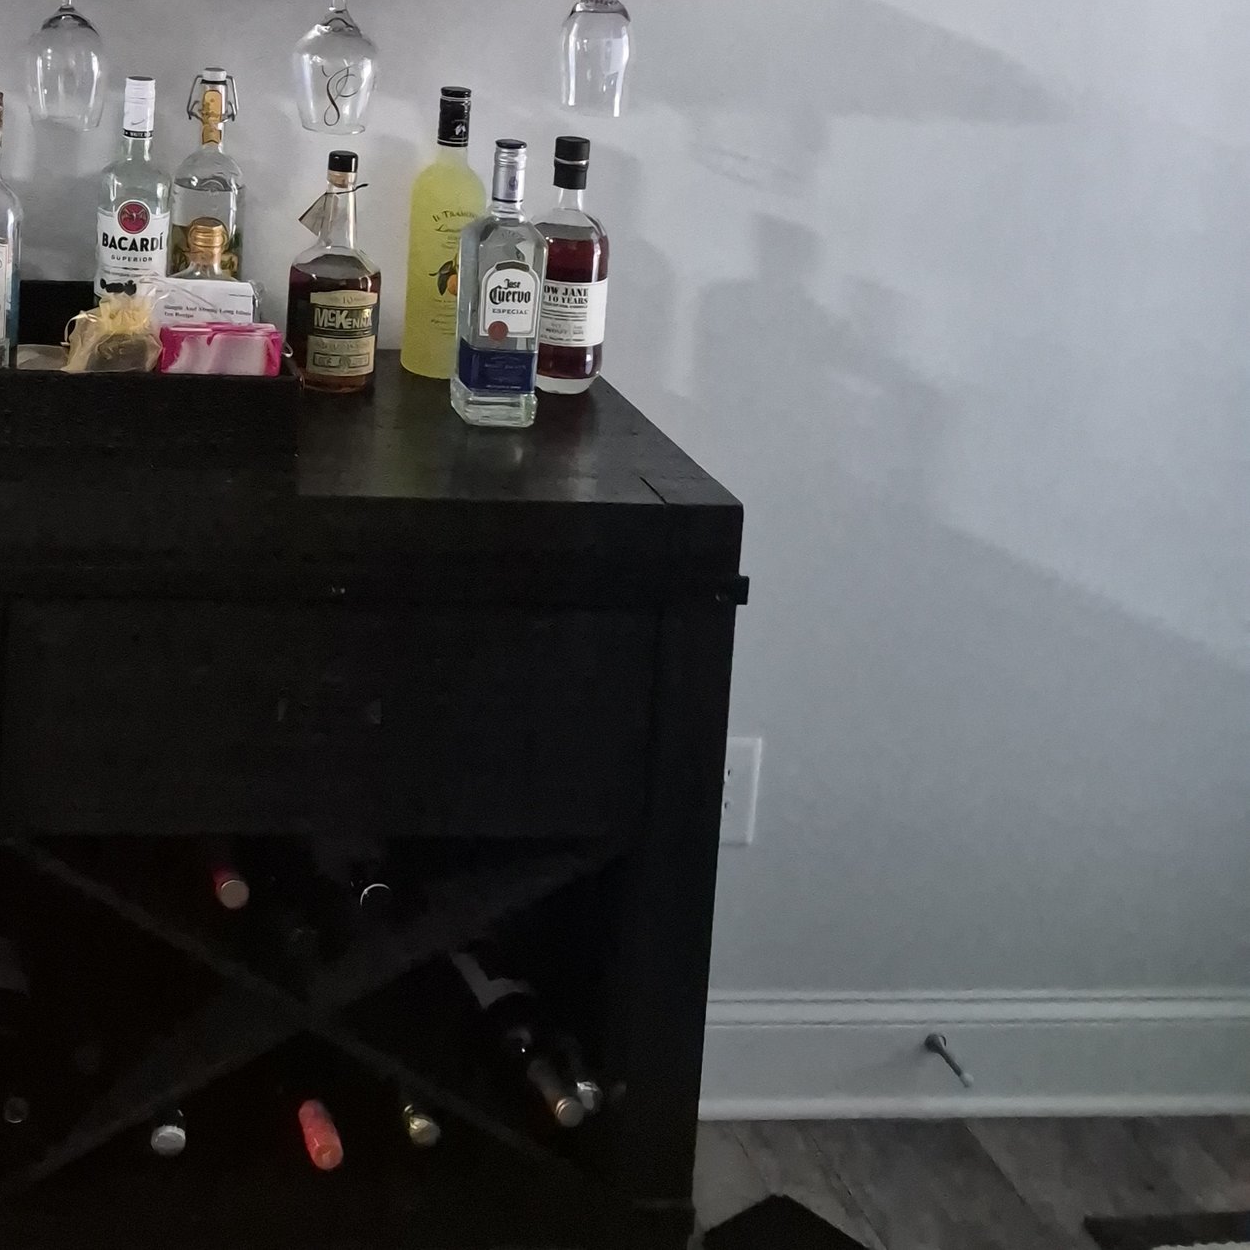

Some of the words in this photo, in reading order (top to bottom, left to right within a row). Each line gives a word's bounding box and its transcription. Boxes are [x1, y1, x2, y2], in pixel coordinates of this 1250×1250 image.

[102, 232, 164, 252] BACARDÍ
[111, 254, 153, 263] SUPERIOR
[489, 284, 531, 305] Cuervo
[562, 287, 589, 297] JANE
[561, 296, 589, 305] YEARS
